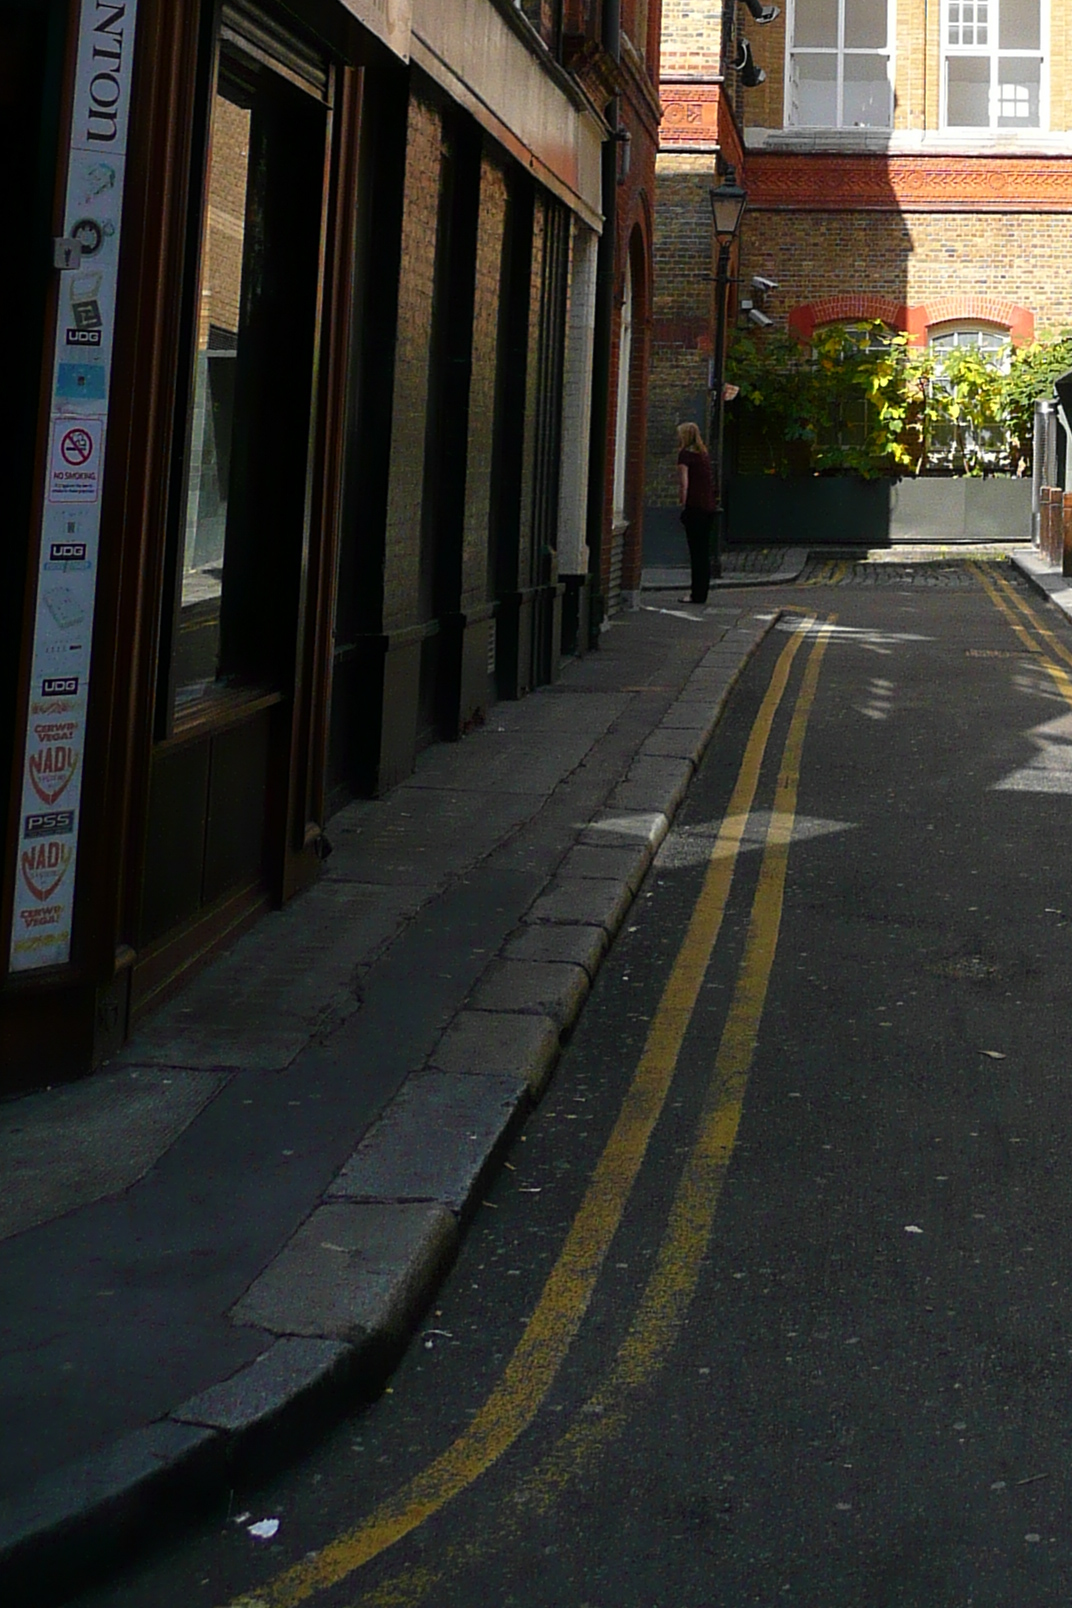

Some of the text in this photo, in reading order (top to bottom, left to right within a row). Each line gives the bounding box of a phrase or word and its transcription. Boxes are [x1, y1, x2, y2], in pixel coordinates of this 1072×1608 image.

[68, 331, 99, 342] UDG
[53, 471, 96, 480] NO SMOKING
[53, 546, 84, 556] UDG
[44, 680, 76, 691] UDG
[28, 813, 70, 830] PSS
